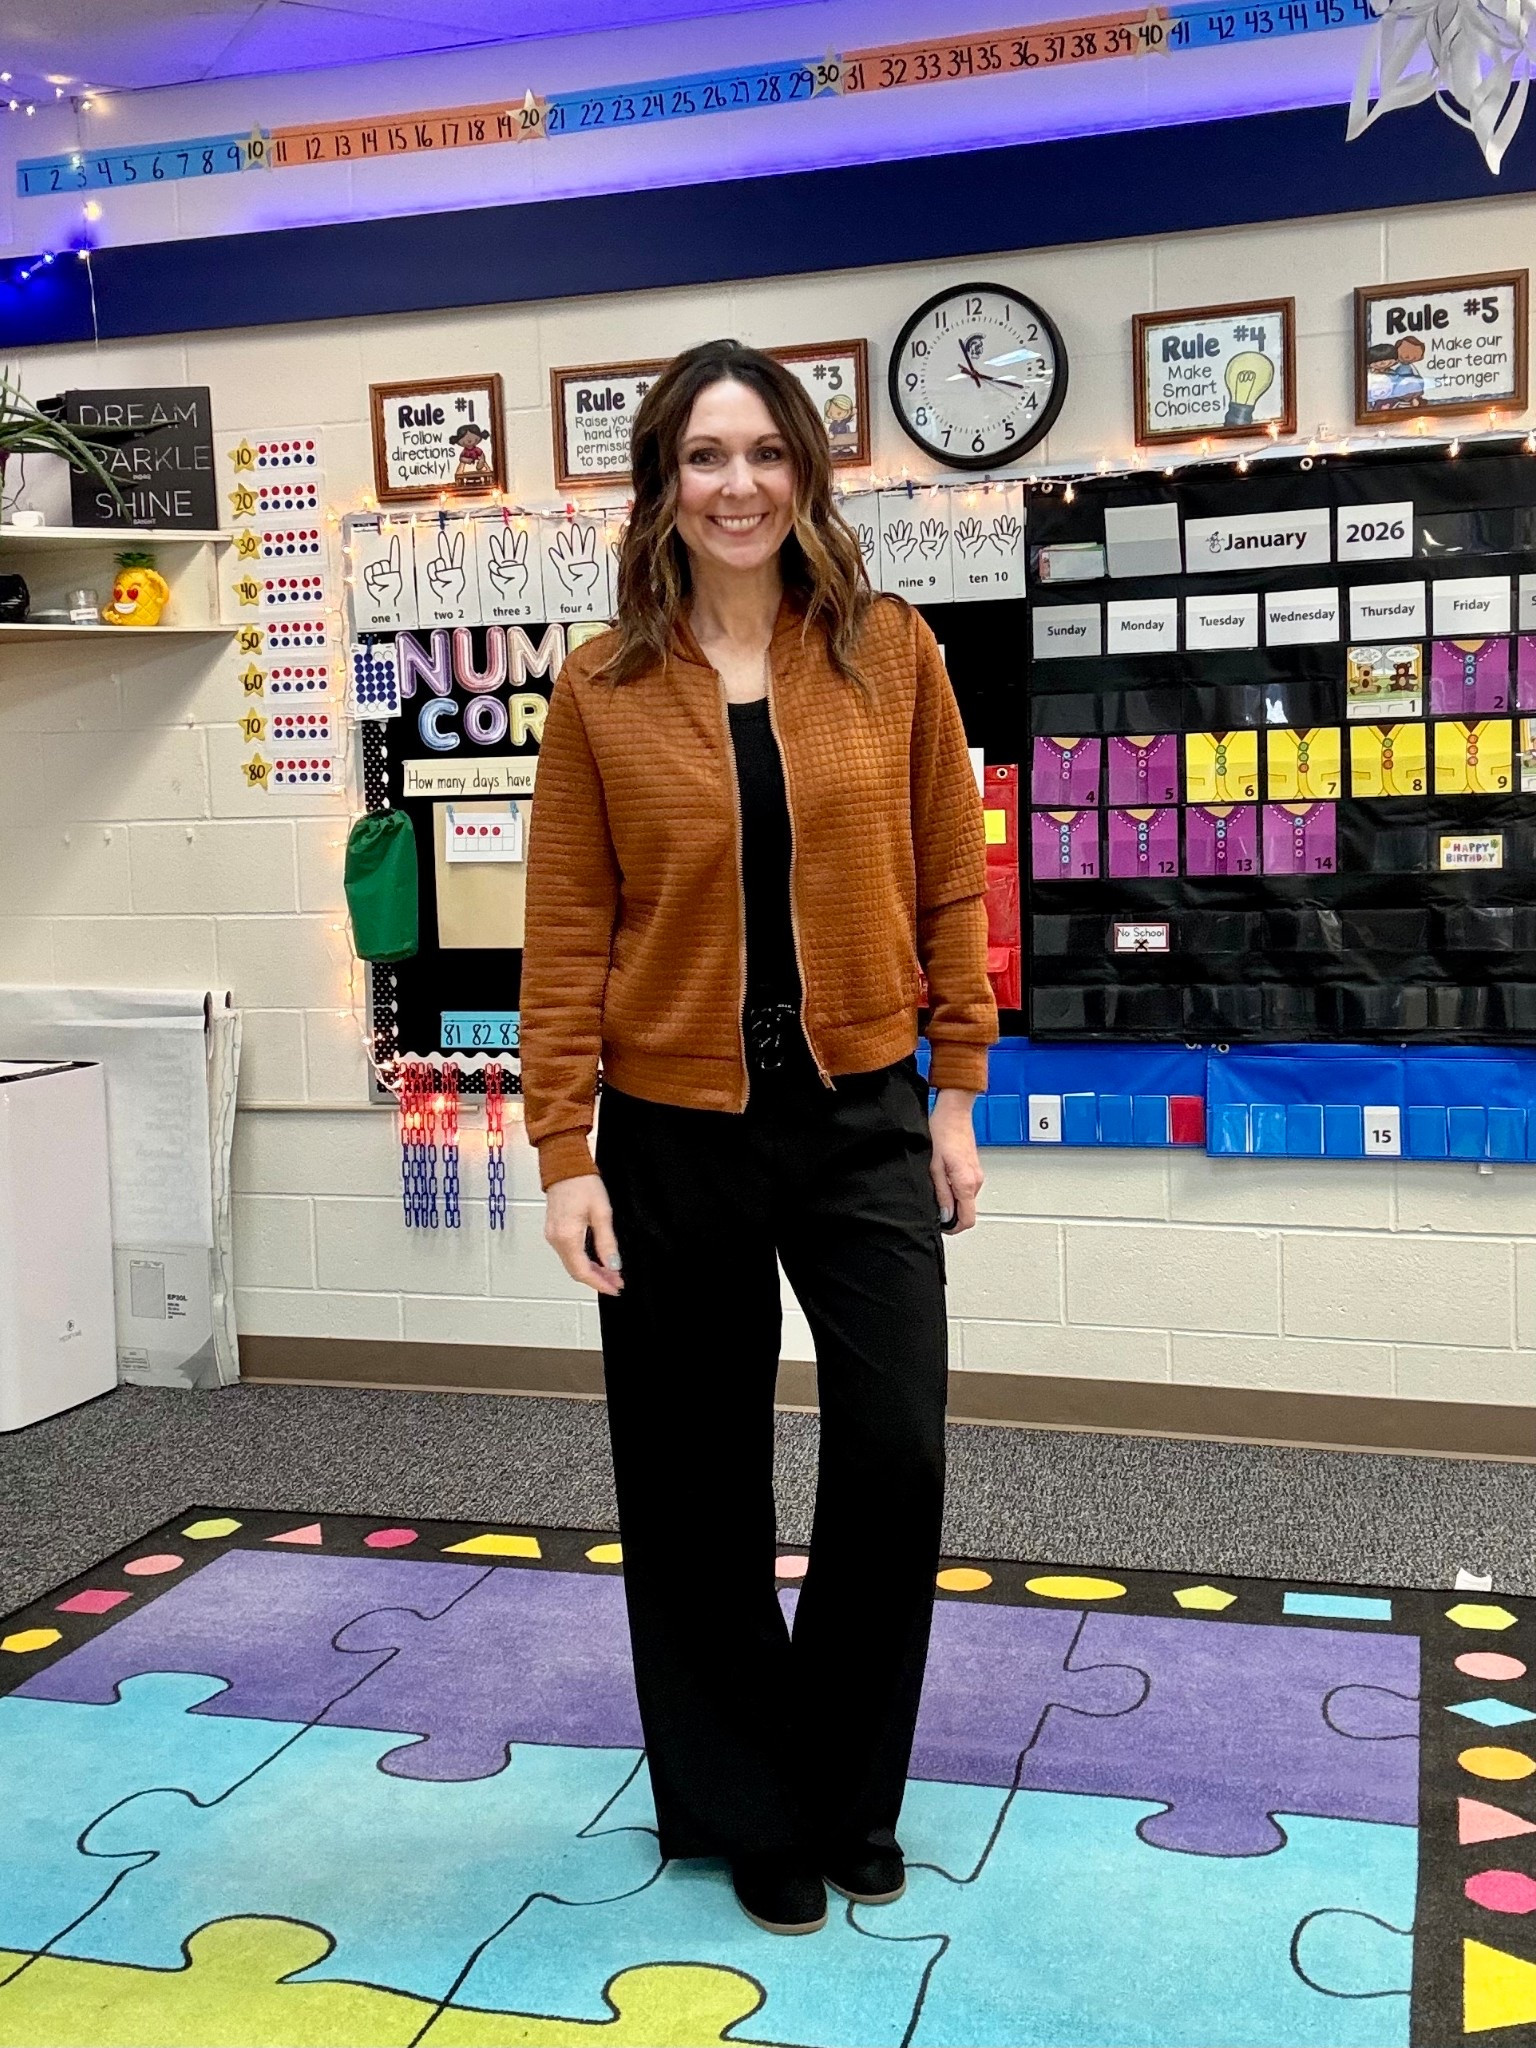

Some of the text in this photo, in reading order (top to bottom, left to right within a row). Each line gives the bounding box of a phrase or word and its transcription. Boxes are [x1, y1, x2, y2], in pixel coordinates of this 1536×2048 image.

[24, 172, 29, 191] 1
[50, 169, 60, 191] 2
[77, 166, 86, 188] 3
[99, 158, 112, 184] 4
[122, 159, 137, 181] 5
[152, 157, 164, 179] 6
[177, 154, 188, 174] 7
[202, 146, 213, 174] 8
[228, 146, 240, 169] 9
[248, 141, 263, 159] 10
[276, 142, 287, 161] 11
[306, 140, 321, 160] 12
[335, 136, 351, 156] 13
[362, 129, 377, 153] 14
[388, 128, 407, 150] 15
[415, 125, 432, 147] 16
[442, 124, 458, 145] 17
[468, 120, 485, 140] 18
[519, 109, 539, 129] 20
[549, 104, 565, 129] 21
[581, 102, 604, 126] 22
[613, 99, 635, 121] 23
[642, 94, 665, 118] 24
[671, 91, 695, 114] 25
[704, 85, 726, 109] 26
[731, 81, 749, 102] 27
[757, 76, 780, 101] 28
[789, 71, 814, 98] 29
[817, 64, 839, 84] 30
[848, 68, 864, 90] 31
[879, 59, 906, 88] 32
[915, 54, 941, 80] 33
[948, 47, 971, 76] 34
[977, 44, 1001, 70] 35
[1010, 42, 1039, 67] 36
[1044, 34, 1066, 62] 37
[1072, 33, 1096, 59] 38
[1104, 28, 1131, 52] 39
[1138, 25, 1162, 46] 40
[1171, 21, 1189, 44] 41
[1209, 16, 1234, 39] 42
[1245, 11, 1272, 33] 43
[1279, 1, 1309, 29] 44
[1316, 0, 1344, 24] 45
[966, 298, 982, 315] 12
[1005, 304, 1010, 321] 1
[935, 311, 946, 328] 11
[1386, 296, 1499, 335] Rule #5
[1027, 324, 1038, 341] 2
[911, 340, 927, 358] 10
[1162, 325, 1266, 363] Rule #4
[1432, 335, 1502, 352] Make our
[1426, 352, 1507, 370] dear team
[813, 364, 842, 390] #3
[1168, 365, 1211, 381] Make
[1434, 370, 1500, 387] stronger
[905, 373, 918, 392] 9
[1163, 380, 1217, 398] Smart
[576, 387, 625, 414] Rule
[1024, 391, 1038, 410] 4
[1155, 395, 1226, 417] Choices!
[80, 402, 197, 429] DREAM
[398, 397, 474, 429] Rule #1
[915, 407, 927, 426] 8
[575, 416, 608, 428] Raise
[402, 431, 442, 445] Follow
[584, 427, 611, 441] hand
[941, 430, 951, 448] 7
[1004, 422, 1015, 440] 5
[577, 441, 630, 457] permissio
[972, 434, 984, 452] 6
[73, 446, 210, 473] PARKLE
[237, 448, 250, 466] 10
[392, 446, 455, 461] directions
[581, 456, 593, 467] to
[398, 460, 450, 480] quickly!
[95, 491, 193, 519] SHINE
[235, 493, 253, 511] 20
[1224, 521, 1405, 550] January 2026
[239, 538, 255, 554] 30
[898, 576, 936, 588] nine 9
[969, 572, 1008, 583] ten 10
[241, 583, 257, 599] 40
[434, 609, 464, 620] two 2
[493, 605, 532, 616] three 3
[560, 603, 593, 614] four 4
[371, 613, 400, 624] one 1
[1047, 599, 1490, 636] Sunday Monday Tuesday Wednesday Thursday Friday
[242, 633, 259, 650] 50
[395, 622, 611, 698] NUM
[244, 675, 262, 691] 60
[1409, 696, 1504, 713] 1 2
[240, 719, 260, 735] 70
[418, 693, 550, 751] COR
[249, 764, 265, 780] 80
[408, 768, 531, 794] How many days have
[1085, 776, 1507, 802] 4 5 6 7 8 9
[1453, 843, 1489, 852] HAPPY
[1081, 857, 1332, 875] 11 12 13 14
[1446, 853, 1495, 862] BIRTHDAY
[1134, 927, 1164, 937] School
[444, 1024, 520, 1045] 81 82 83
[1039, 1117, 1049, 1129] 6
[1372, 1130, 1391, 1143] 15
